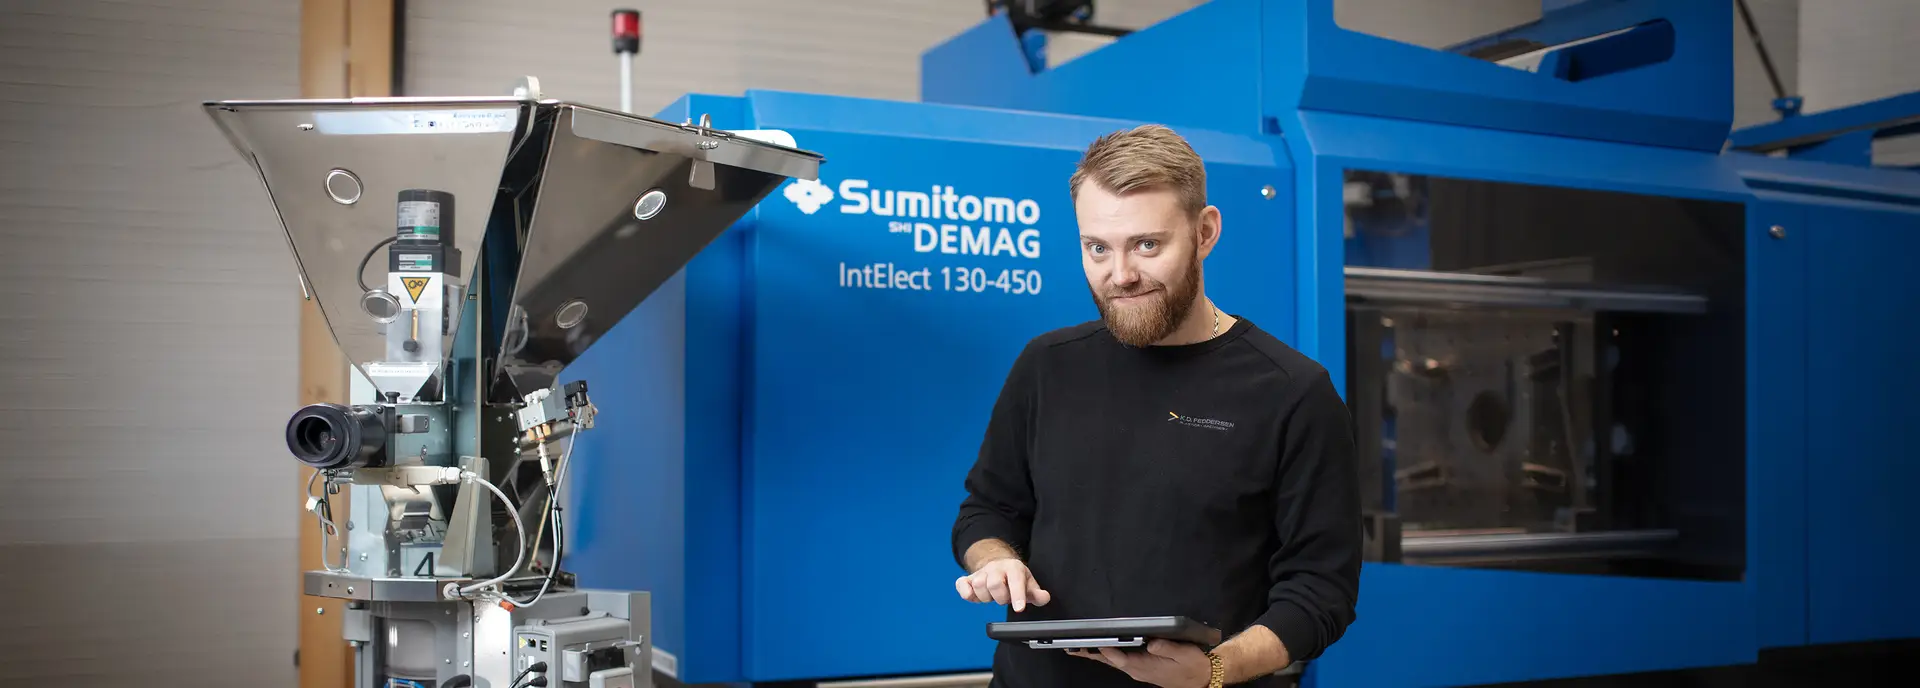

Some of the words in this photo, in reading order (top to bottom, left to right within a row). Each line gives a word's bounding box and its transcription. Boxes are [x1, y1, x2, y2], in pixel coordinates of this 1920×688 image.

[840, 179, 1040, 225] Sumitomo
[889, 222, 912, 234] SHI
[914, 223, 1040, 258] DEMAG
[839, 262, 931, 291] IntElect
[941, 266, 1042, 294] 130-450
